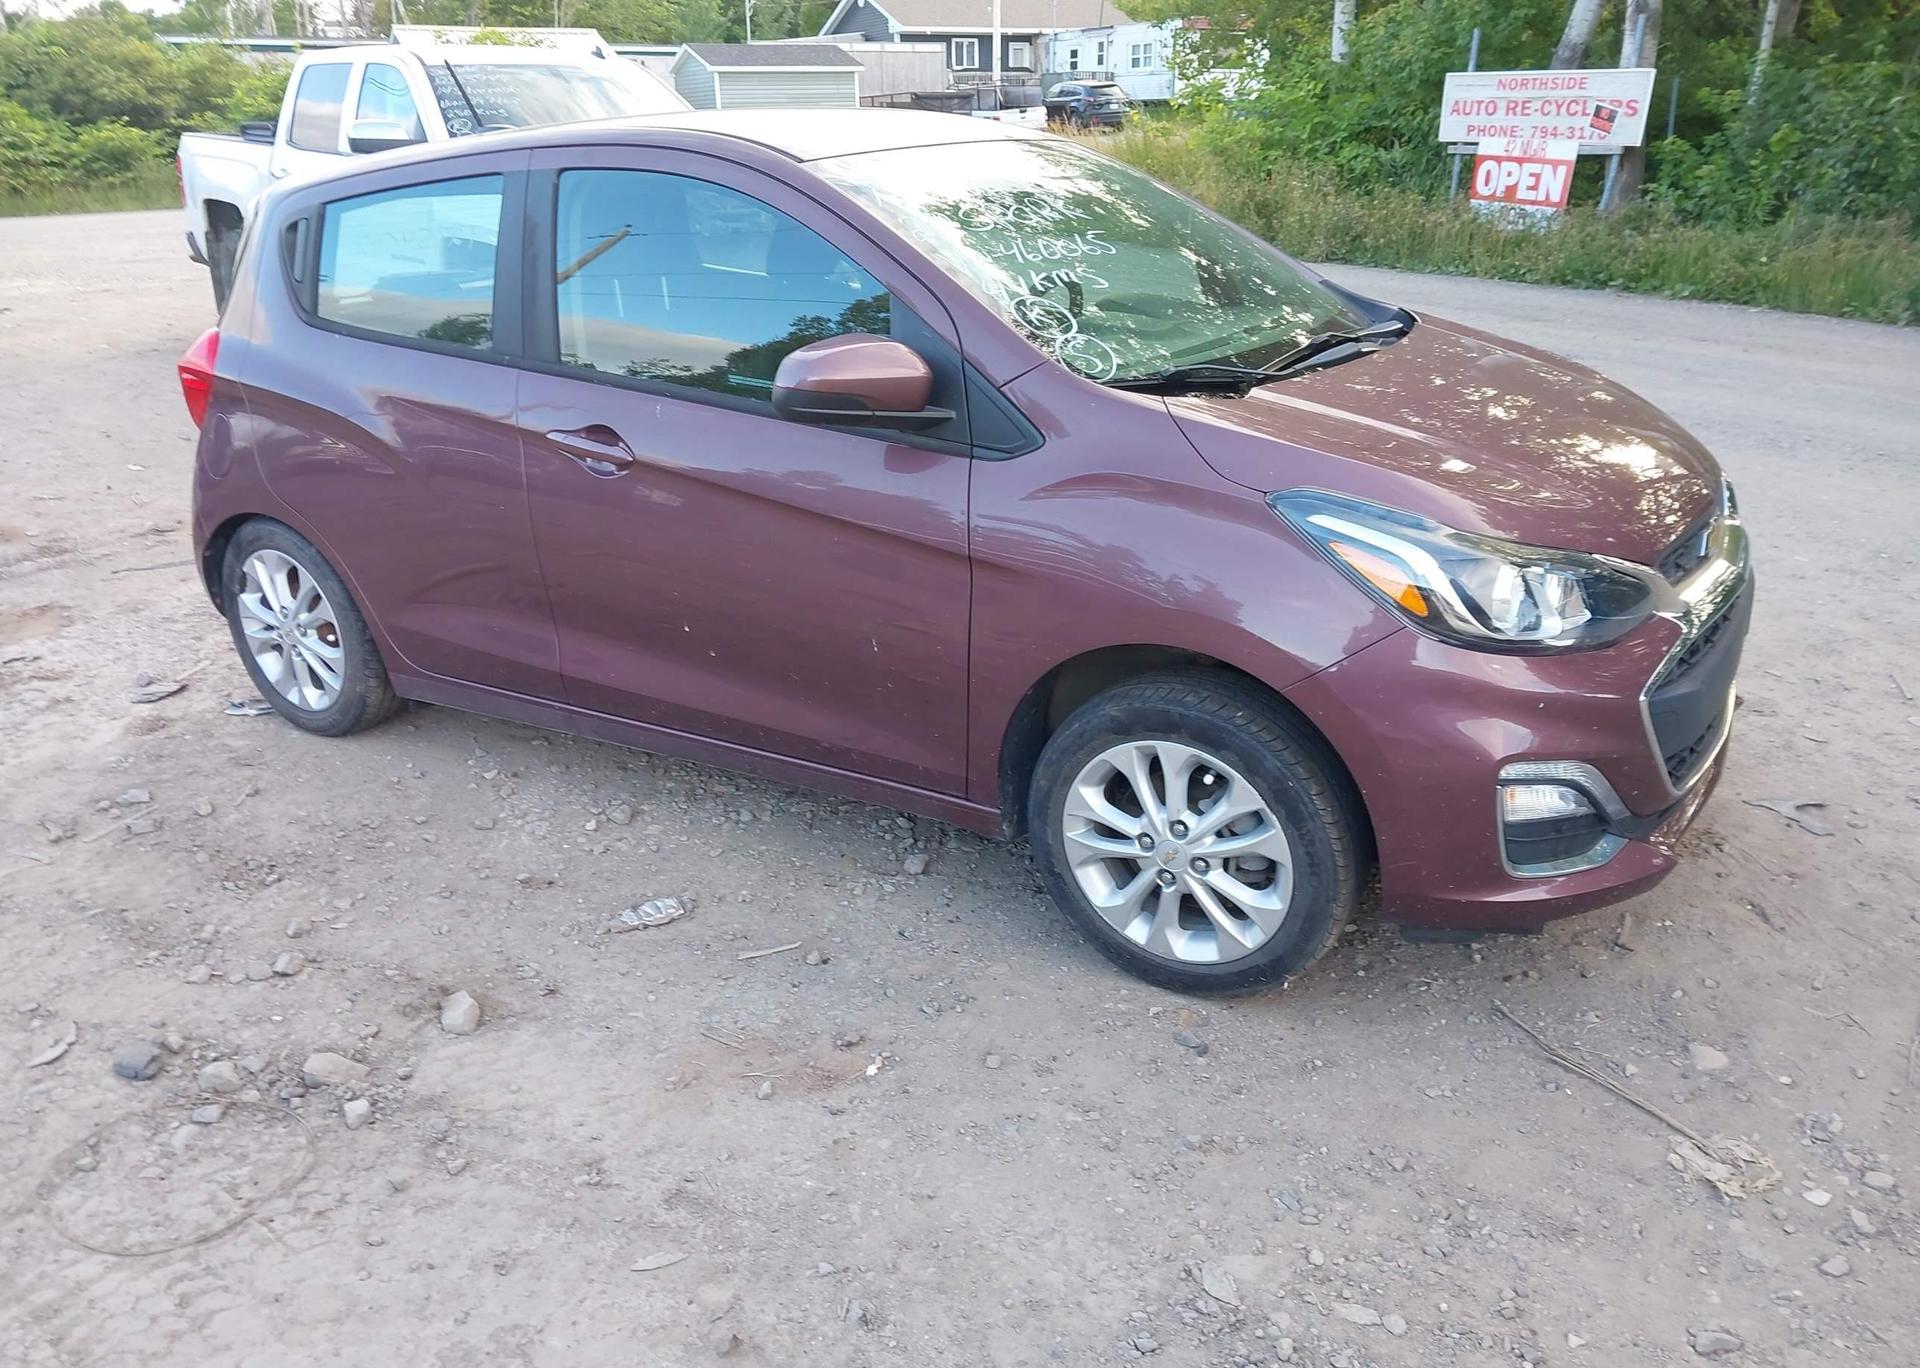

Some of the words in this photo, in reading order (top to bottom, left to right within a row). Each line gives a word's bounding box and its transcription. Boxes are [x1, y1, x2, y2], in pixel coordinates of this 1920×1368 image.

[1497, 76, 1590, 91] NORTHSIDE
[1450, 99, 1498, 117] AUTO
[1505, 98, 1640, 118] RE-CYCLS
[1466, 124, 1525, 139] PHONE:
[1476, 159, 1568, 203] OPEN
